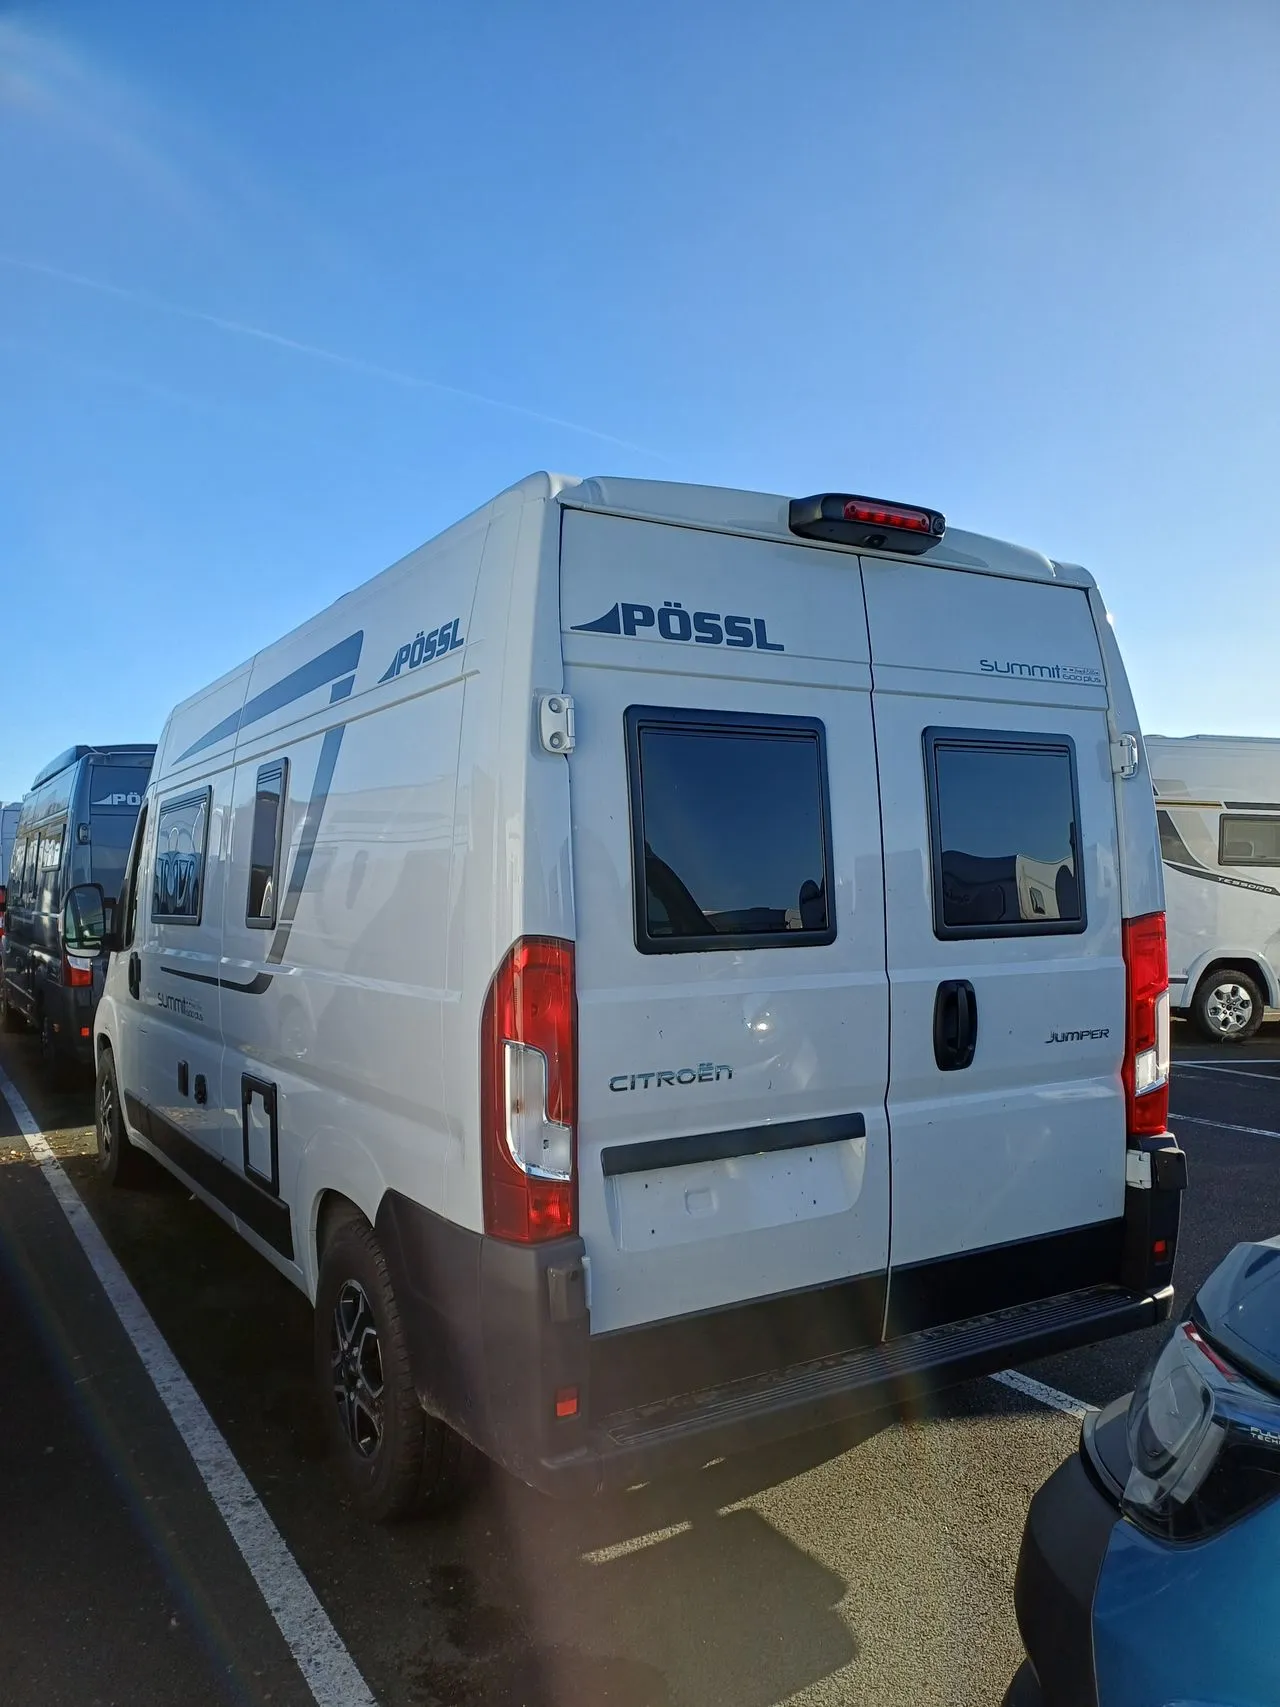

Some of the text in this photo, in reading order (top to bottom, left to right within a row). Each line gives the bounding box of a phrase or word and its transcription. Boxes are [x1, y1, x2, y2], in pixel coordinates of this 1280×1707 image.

[621, 601, 785, 651] PÖSSL
[396, 618, 464, 675] PÖSSL
[979, 659, 1060, 679] summit
[112, 792, 144, 806] PÖ
[1044, 1028, 1110, 1044] JUMPER
